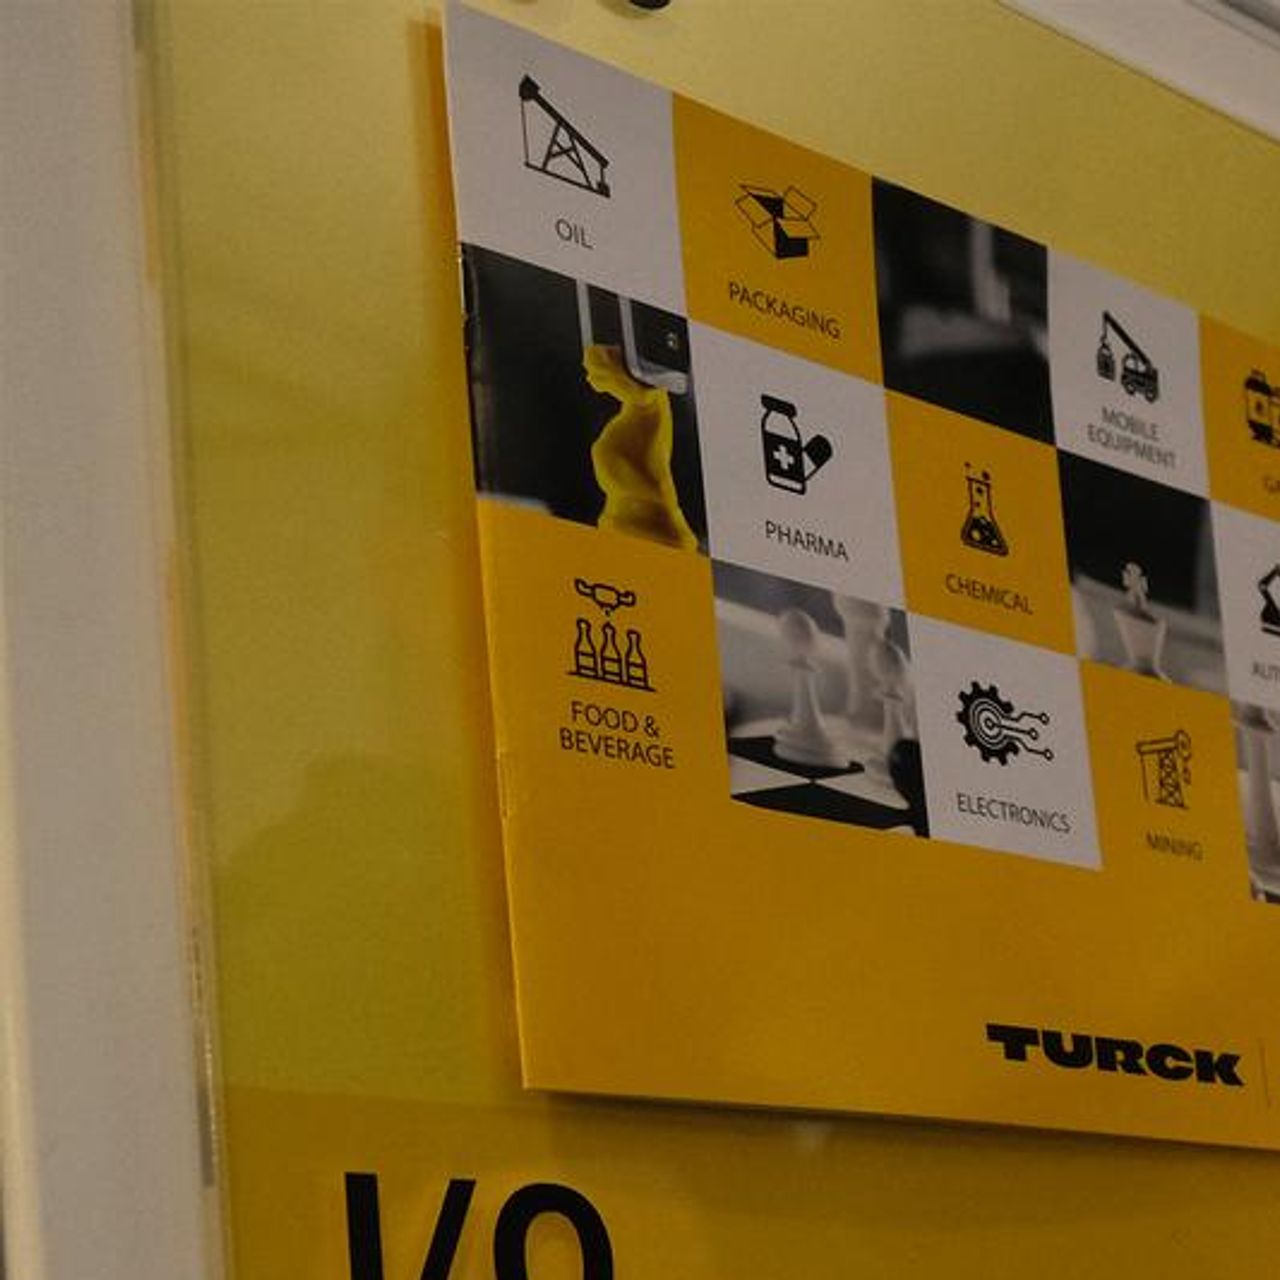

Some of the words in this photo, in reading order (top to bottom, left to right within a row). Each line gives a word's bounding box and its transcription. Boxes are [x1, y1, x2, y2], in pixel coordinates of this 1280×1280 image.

[554, 218, 594, 250] OIL
[727, 280, 842, 341] PACKAGING
[1102, 406, 1160, 442] MOBILE
[1087, 423, 1178, 471] EQUIPMENT
[765, 520, 850, 562] PHARMA
[945, 573, 1034, 616] CHEMICAL
[571, 701, 638, 733] FOOD
[643, 715, 661, 739] &
[560, 727, 675, 769] BEVERAGE
[956, 793, 1071, 835] ELECTRONICS
[1145, 831, 1204, 863] MINING
[985, 1023, 1245, 1087] TURCK
